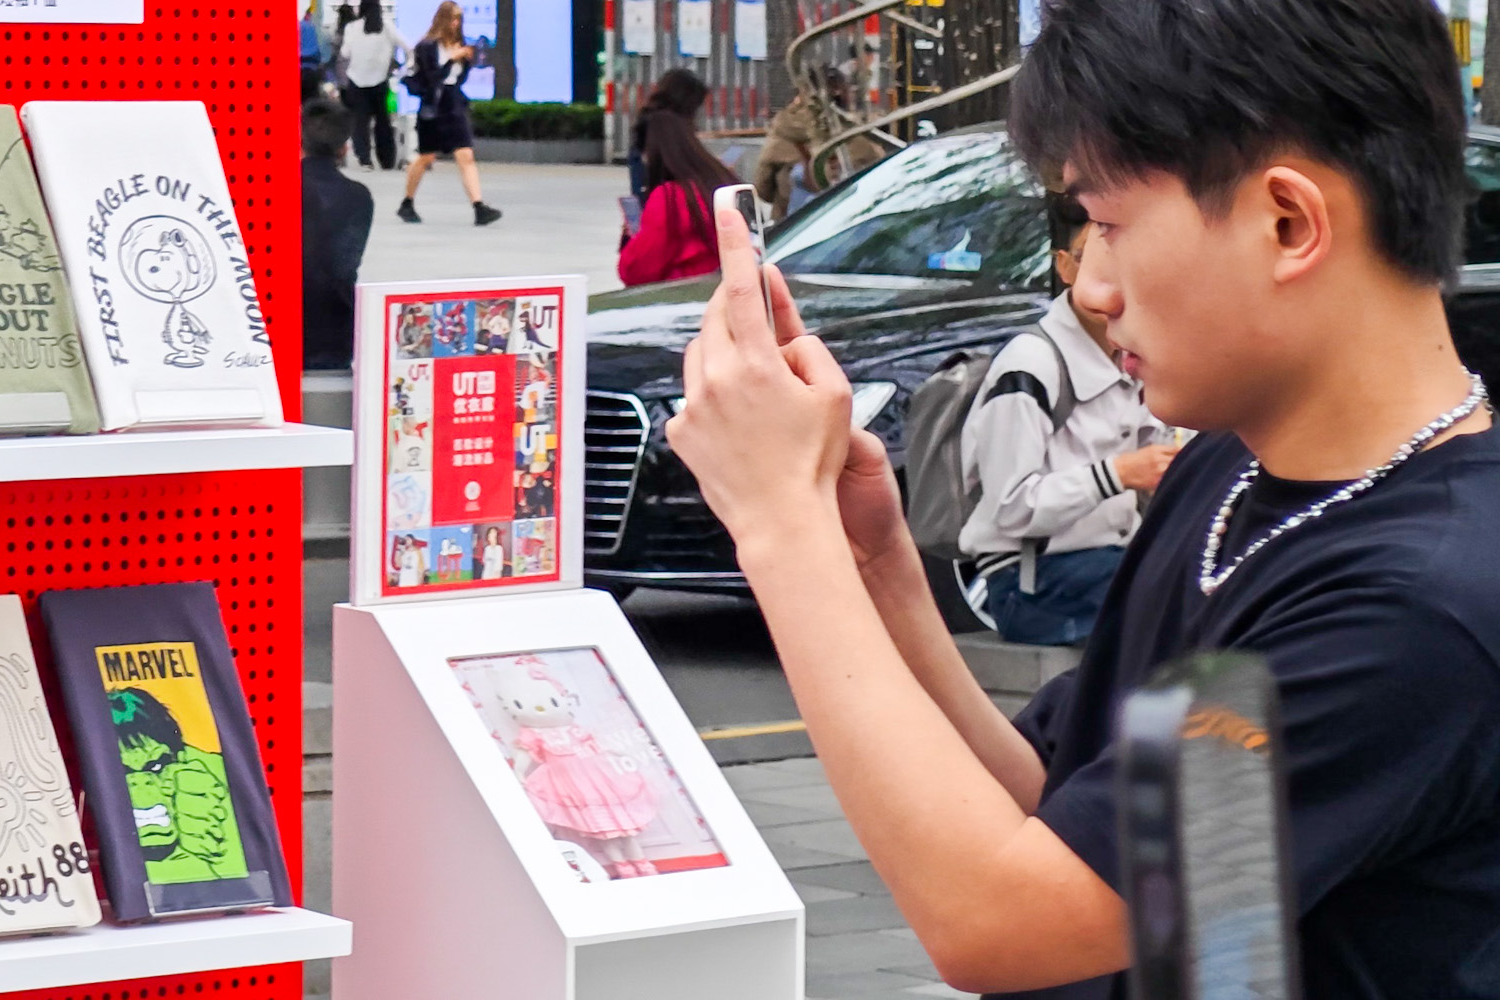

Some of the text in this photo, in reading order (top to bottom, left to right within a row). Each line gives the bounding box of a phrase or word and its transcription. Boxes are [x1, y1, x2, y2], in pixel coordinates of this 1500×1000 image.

[87, 173, 273, 368] FIRST BEAGLE ON THE MOON
[102, 648, 194, 682] MARVEL
[53, 841, 90, 877] 88
